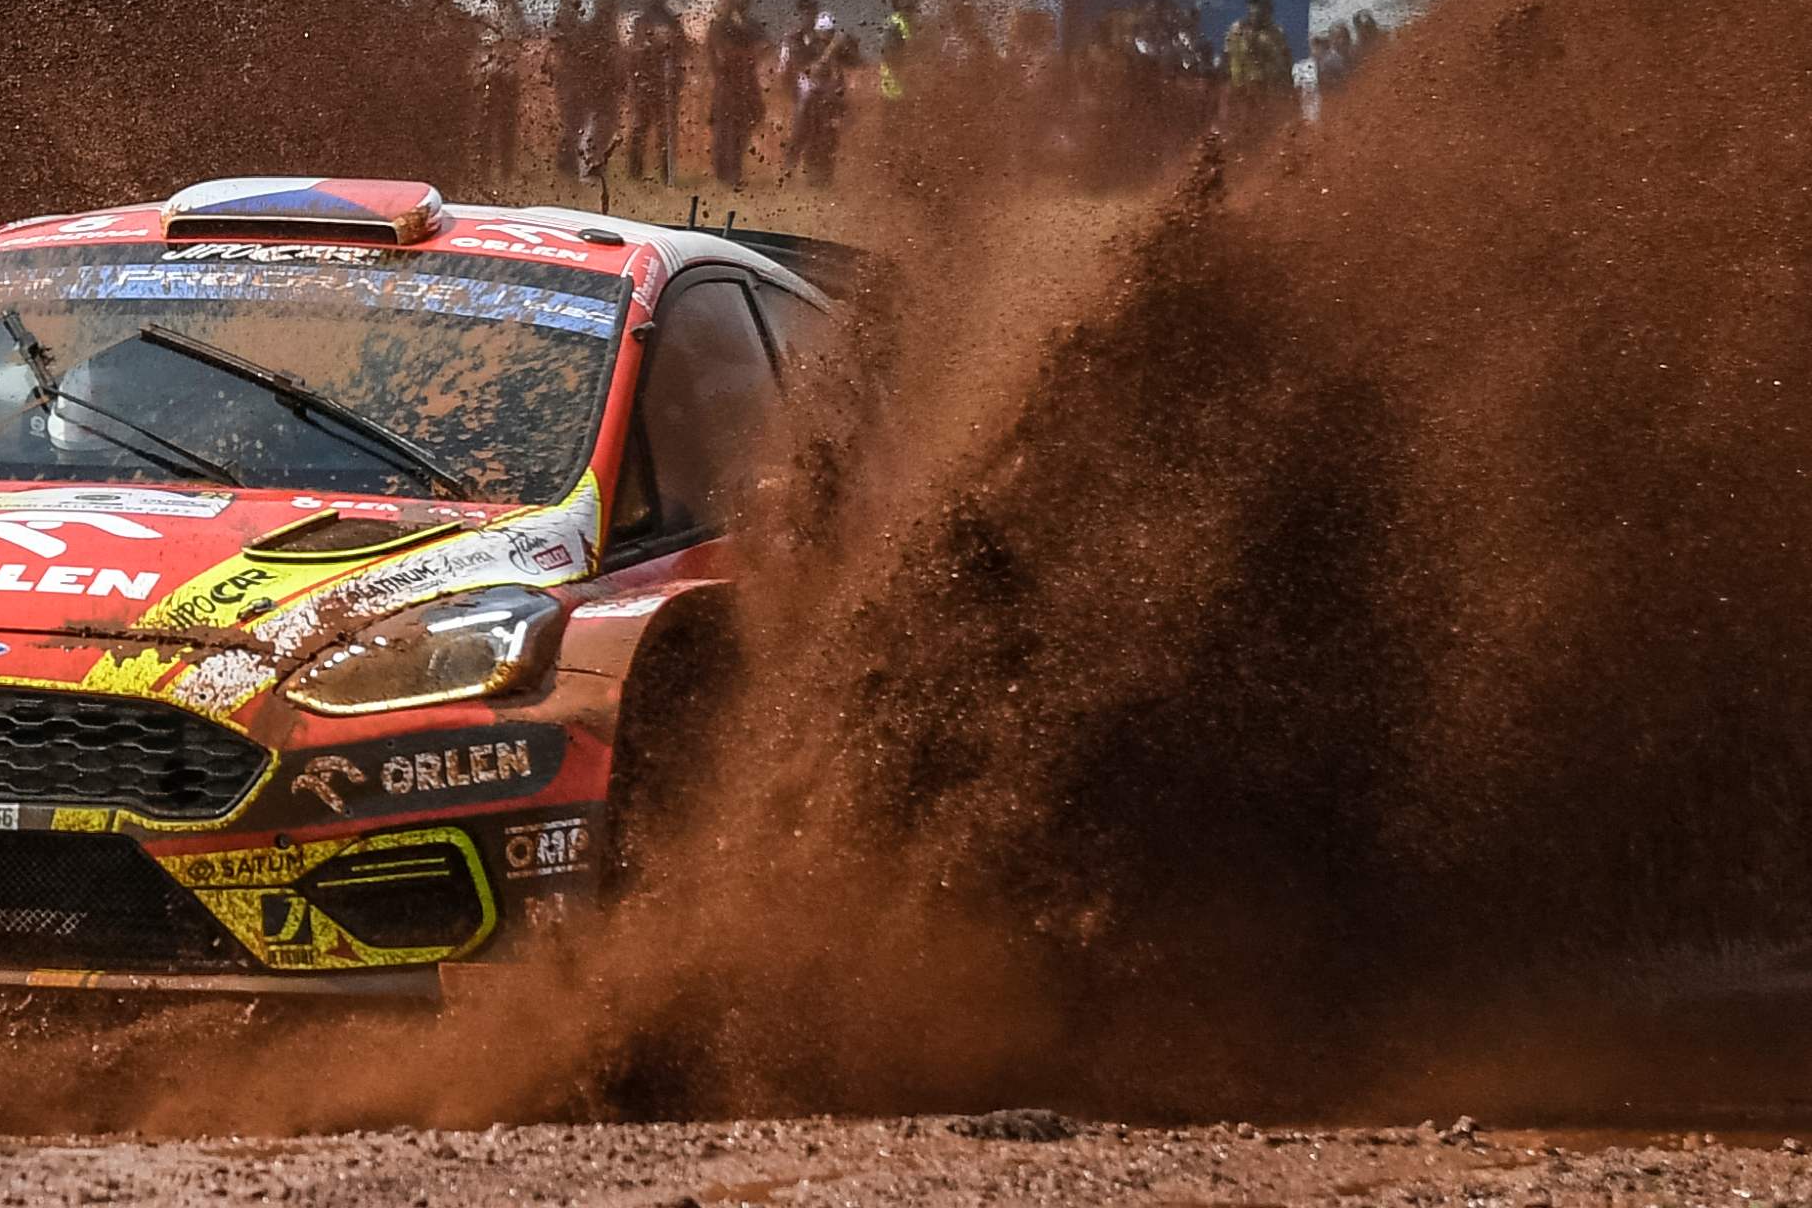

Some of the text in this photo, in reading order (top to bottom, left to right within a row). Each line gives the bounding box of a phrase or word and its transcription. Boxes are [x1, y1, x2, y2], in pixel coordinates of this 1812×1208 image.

[450, 237, 588, 262] ORLEN
[381, 740, 532, 794] ORLEN
[221, 845, 304, 877] SATUM
[505, 827, 588, 868] OMP
